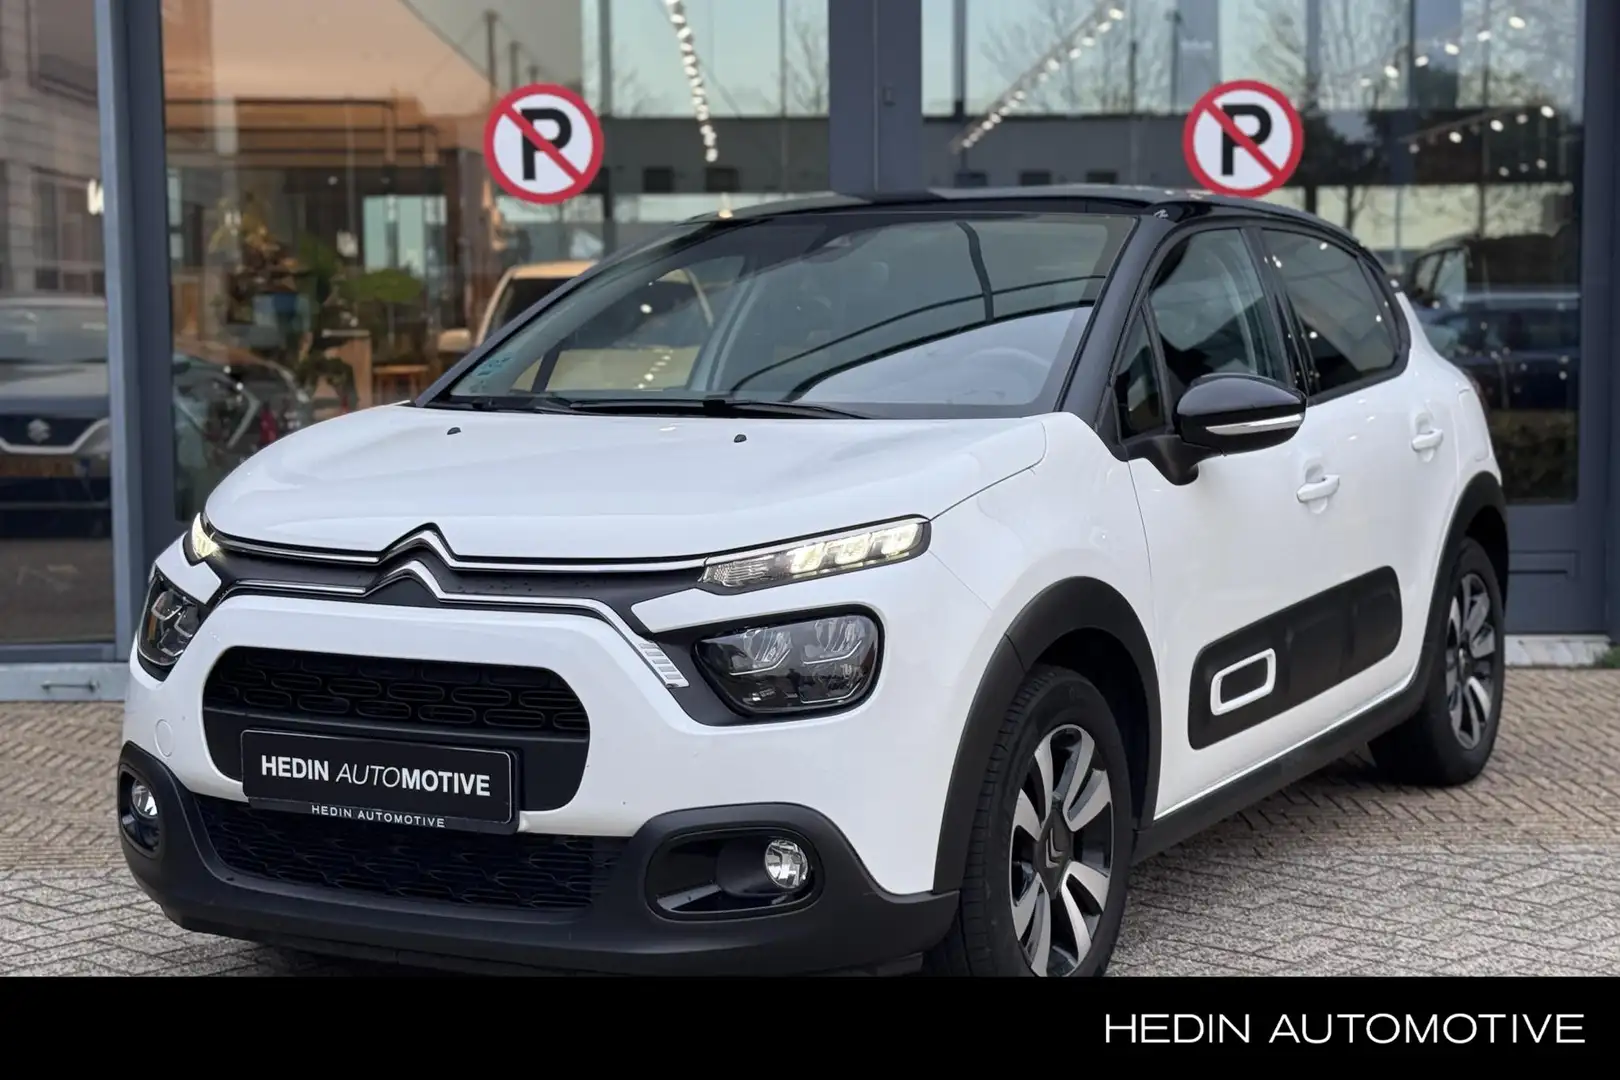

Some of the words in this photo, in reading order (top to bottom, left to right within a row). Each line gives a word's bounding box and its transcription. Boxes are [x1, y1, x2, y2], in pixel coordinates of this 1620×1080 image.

[521, 108, 572, 181] P
[1221, 104, 1272, 176] P
[261, 755, 329, 781] HEDIN
[335, 763, 491, 797] AUTOMOTIVE
[311, 804, 352, 818] HEDIN
[357, 810, 446, 828] AUTOMOTIVE
